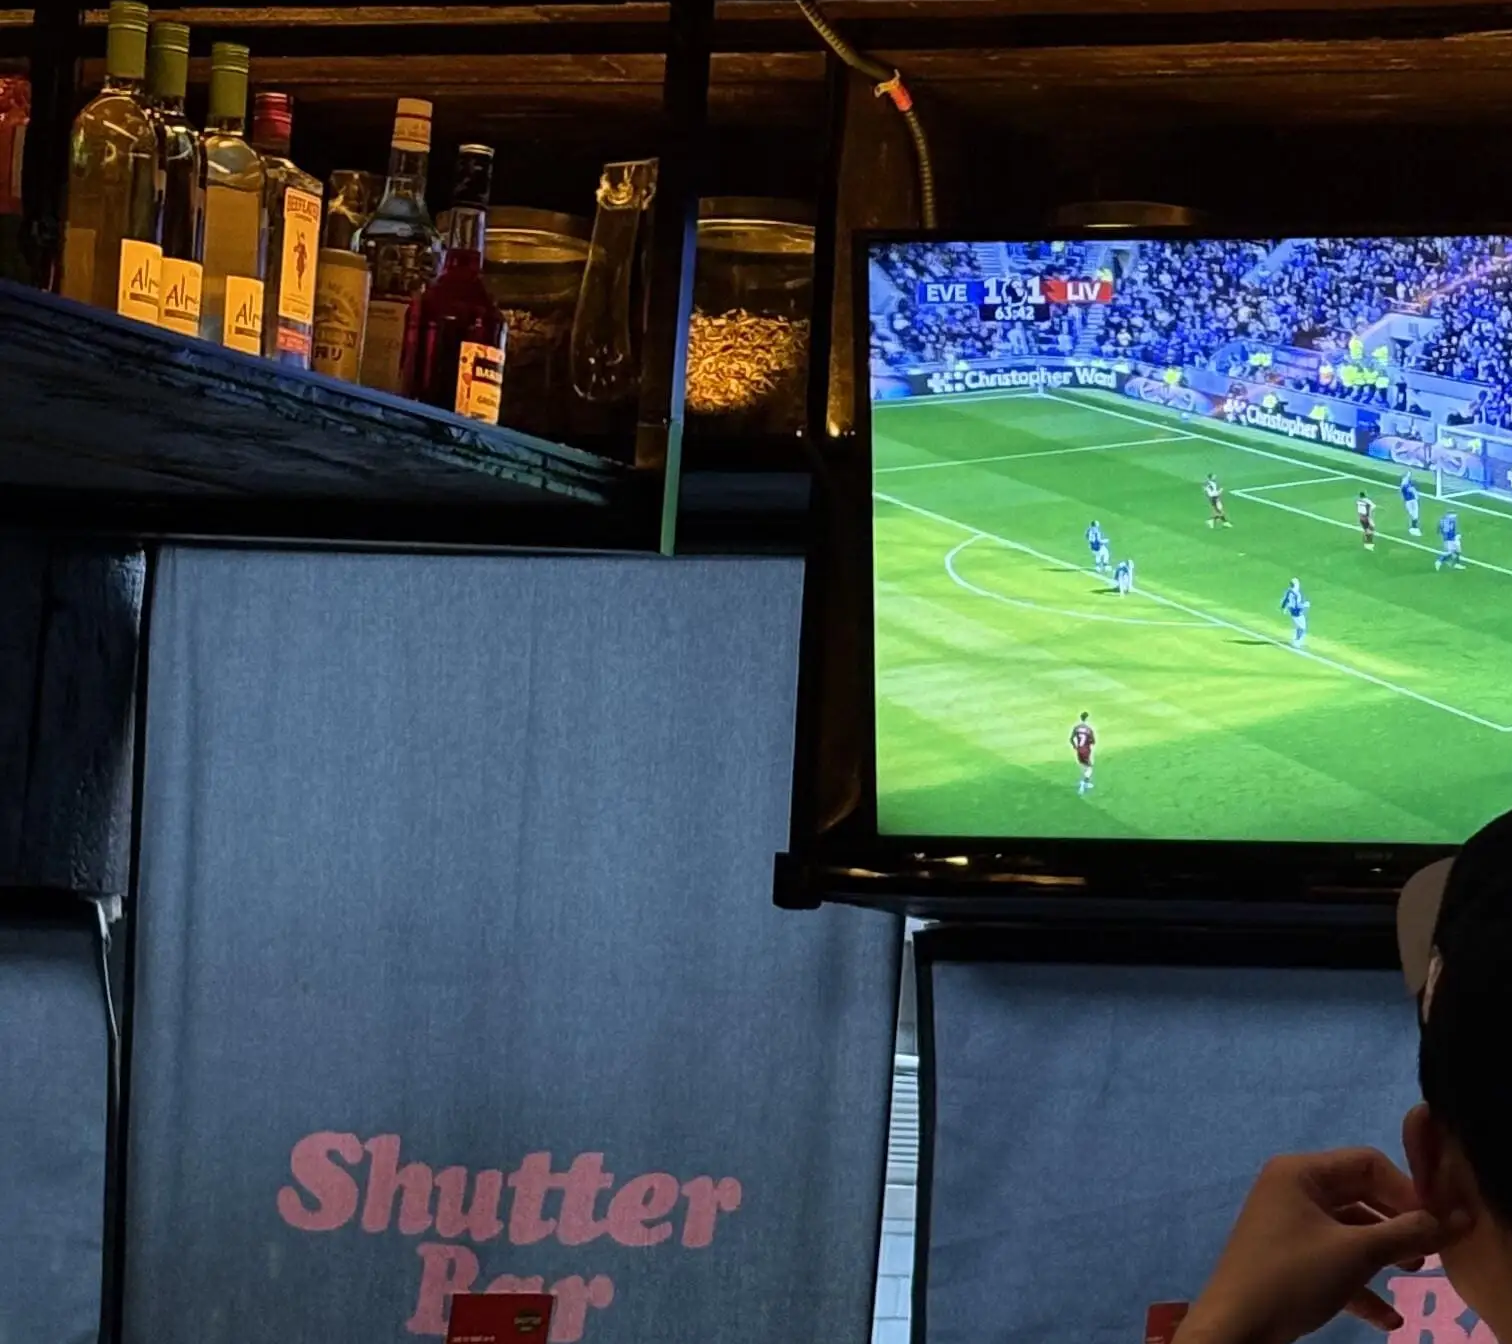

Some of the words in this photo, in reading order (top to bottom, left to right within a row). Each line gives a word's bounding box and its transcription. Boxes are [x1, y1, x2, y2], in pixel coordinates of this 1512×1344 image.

[926, 283, 967, 302] EVE
[983, 276, 1001, 304] 1
[1027, 276, 1046, 304] 1
[1066, 282, 1101, 301] LIV
[994, 305, 1036, 321] 63:42
[964, 367, 1073, 389] Christopher
[276, 1130, 743, 1249] Shutter
[405, 1242, 617, 1344] Br
